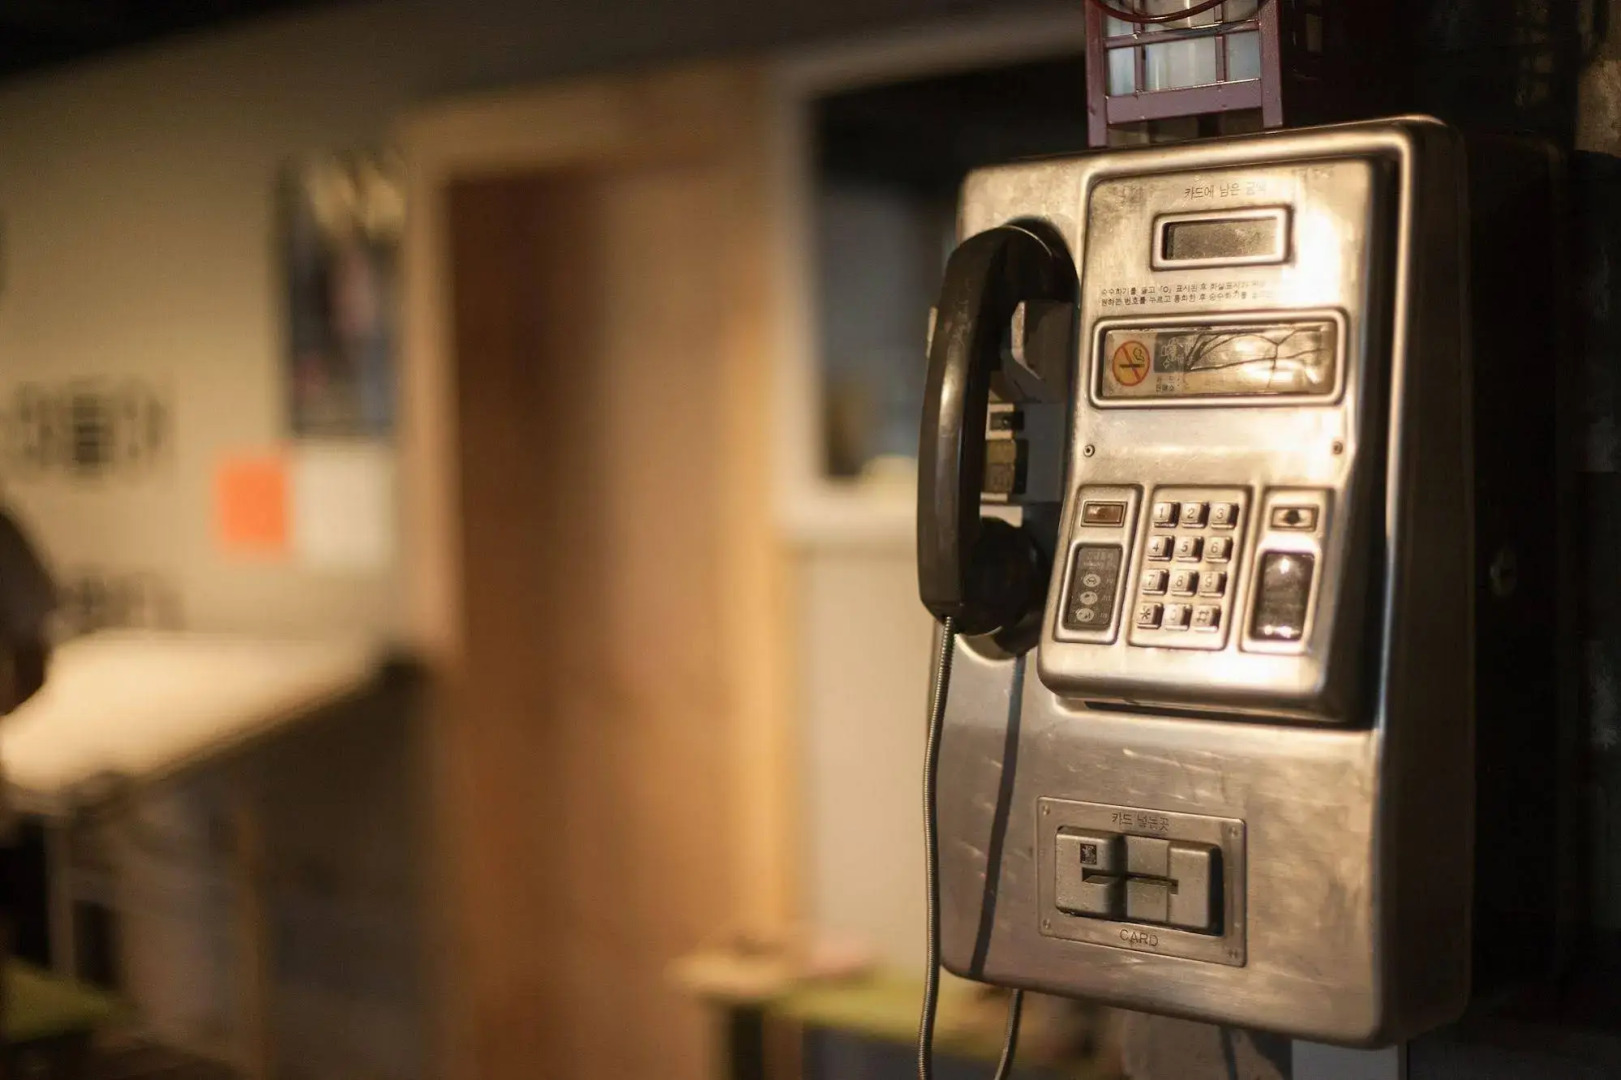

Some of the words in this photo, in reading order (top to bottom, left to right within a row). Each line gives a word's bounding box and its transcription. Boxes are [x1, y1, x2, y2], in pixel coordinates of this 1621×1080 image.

[1183, 185, 1214, 200] 카드에
[1219, 183, 1240, 198] 남은
[1187, 508, 1195, 519] 2
[1216, 508, 1224, 520] 3
[1152, 542, 1159, 553] 4
[1181, 541, 1189, 553] 5
[1211, 542, 1219, 554] 6
[1147, 575, 1155, 586] 7
[1175, 576, 1183, 587] 8
[1205, 575, 1212, 588] 9
[1111, 811, 1133, 826] 카드
[1137, 813, 1170, 831] 넣는곳
[1120, 929, 1159, 947] CARD
